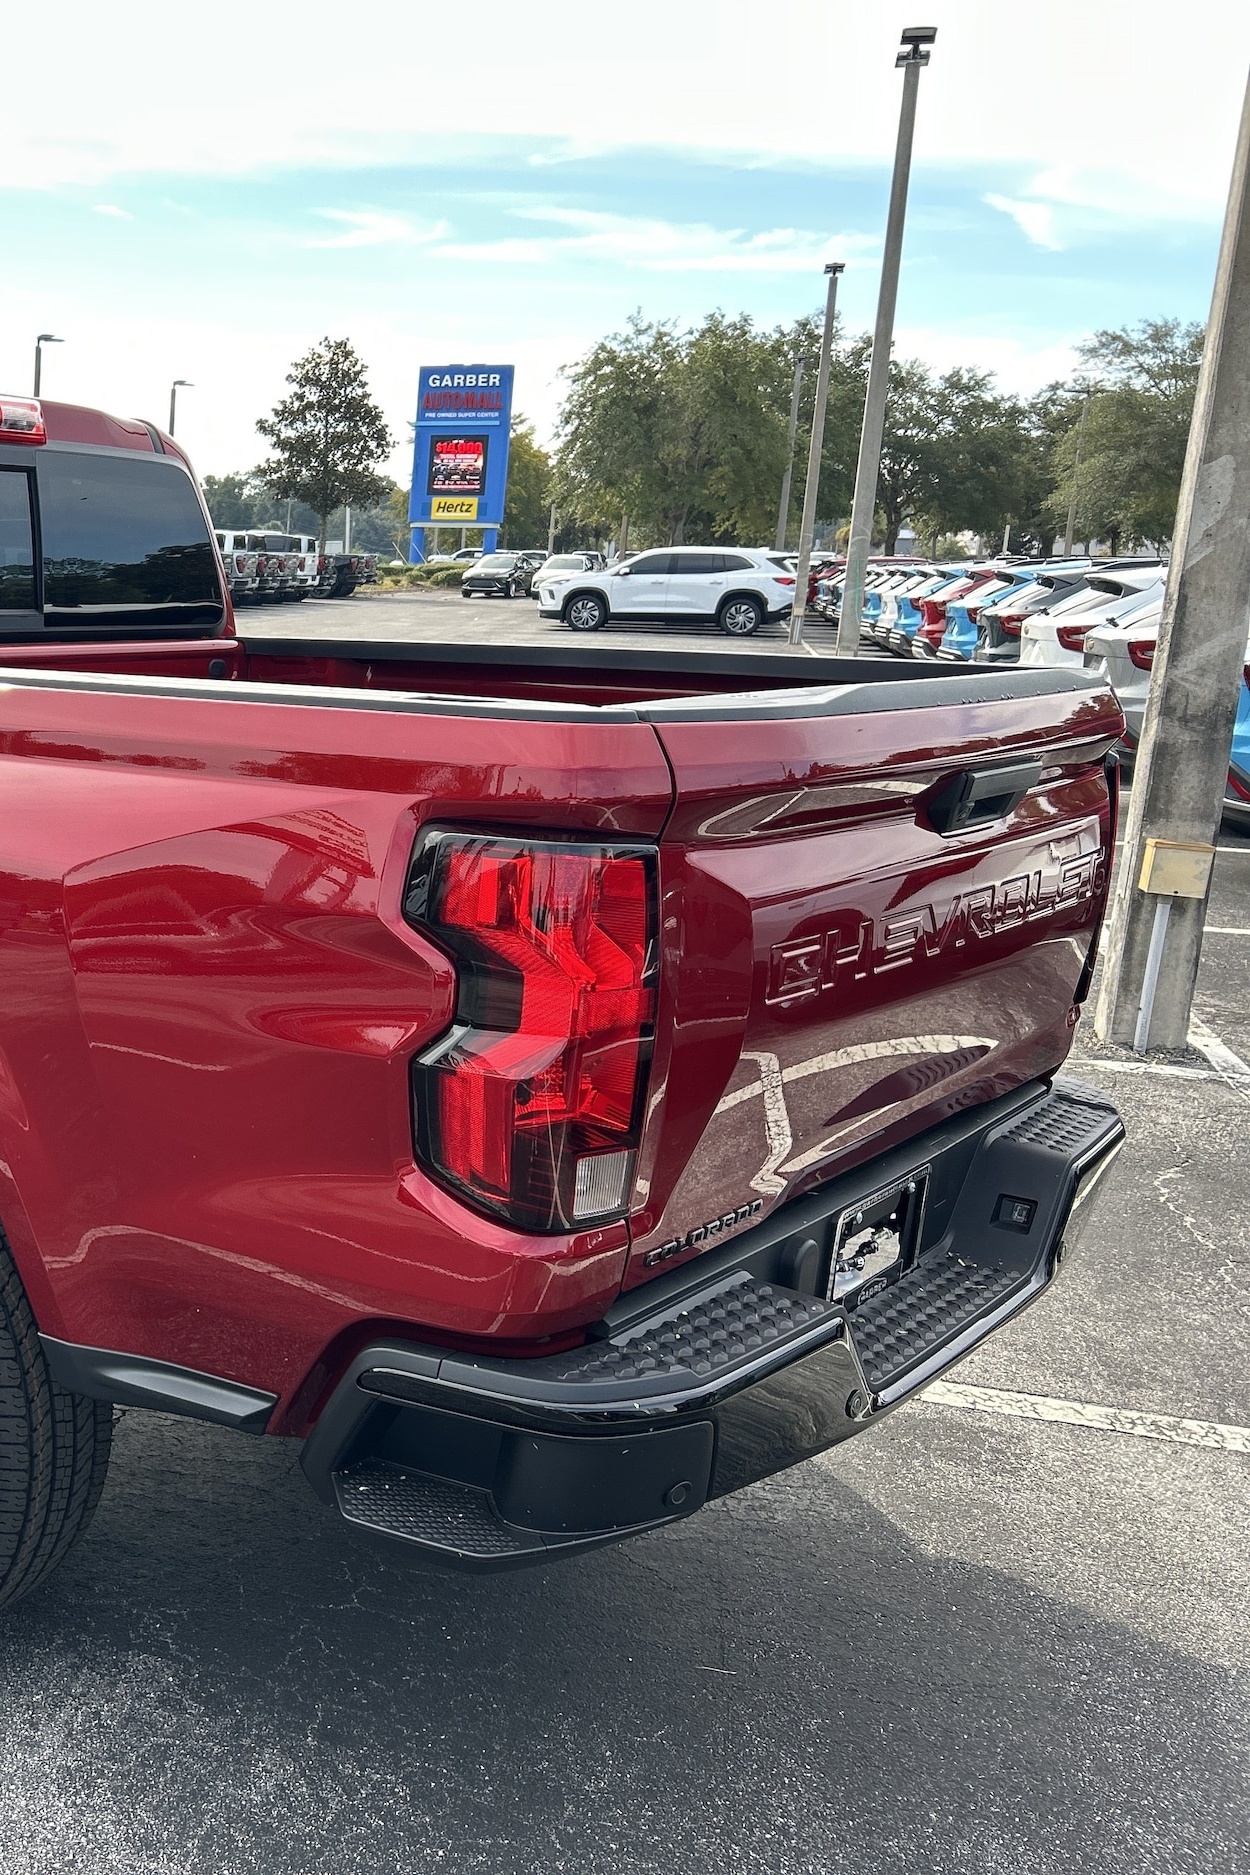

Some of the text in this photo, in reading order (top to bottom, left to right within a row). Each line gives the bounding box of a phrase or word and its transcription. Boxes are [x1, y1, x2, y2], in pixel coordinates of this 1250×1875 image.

[428, 373, 501, 388] GARBER
[422, 391, 503, 410] AUTOMALL
[436, 501, 474, 513] Hertz
[765, 846, 1105, 1006] CHEVROLET
[643, 1199, 763, 1267] COLORADO
